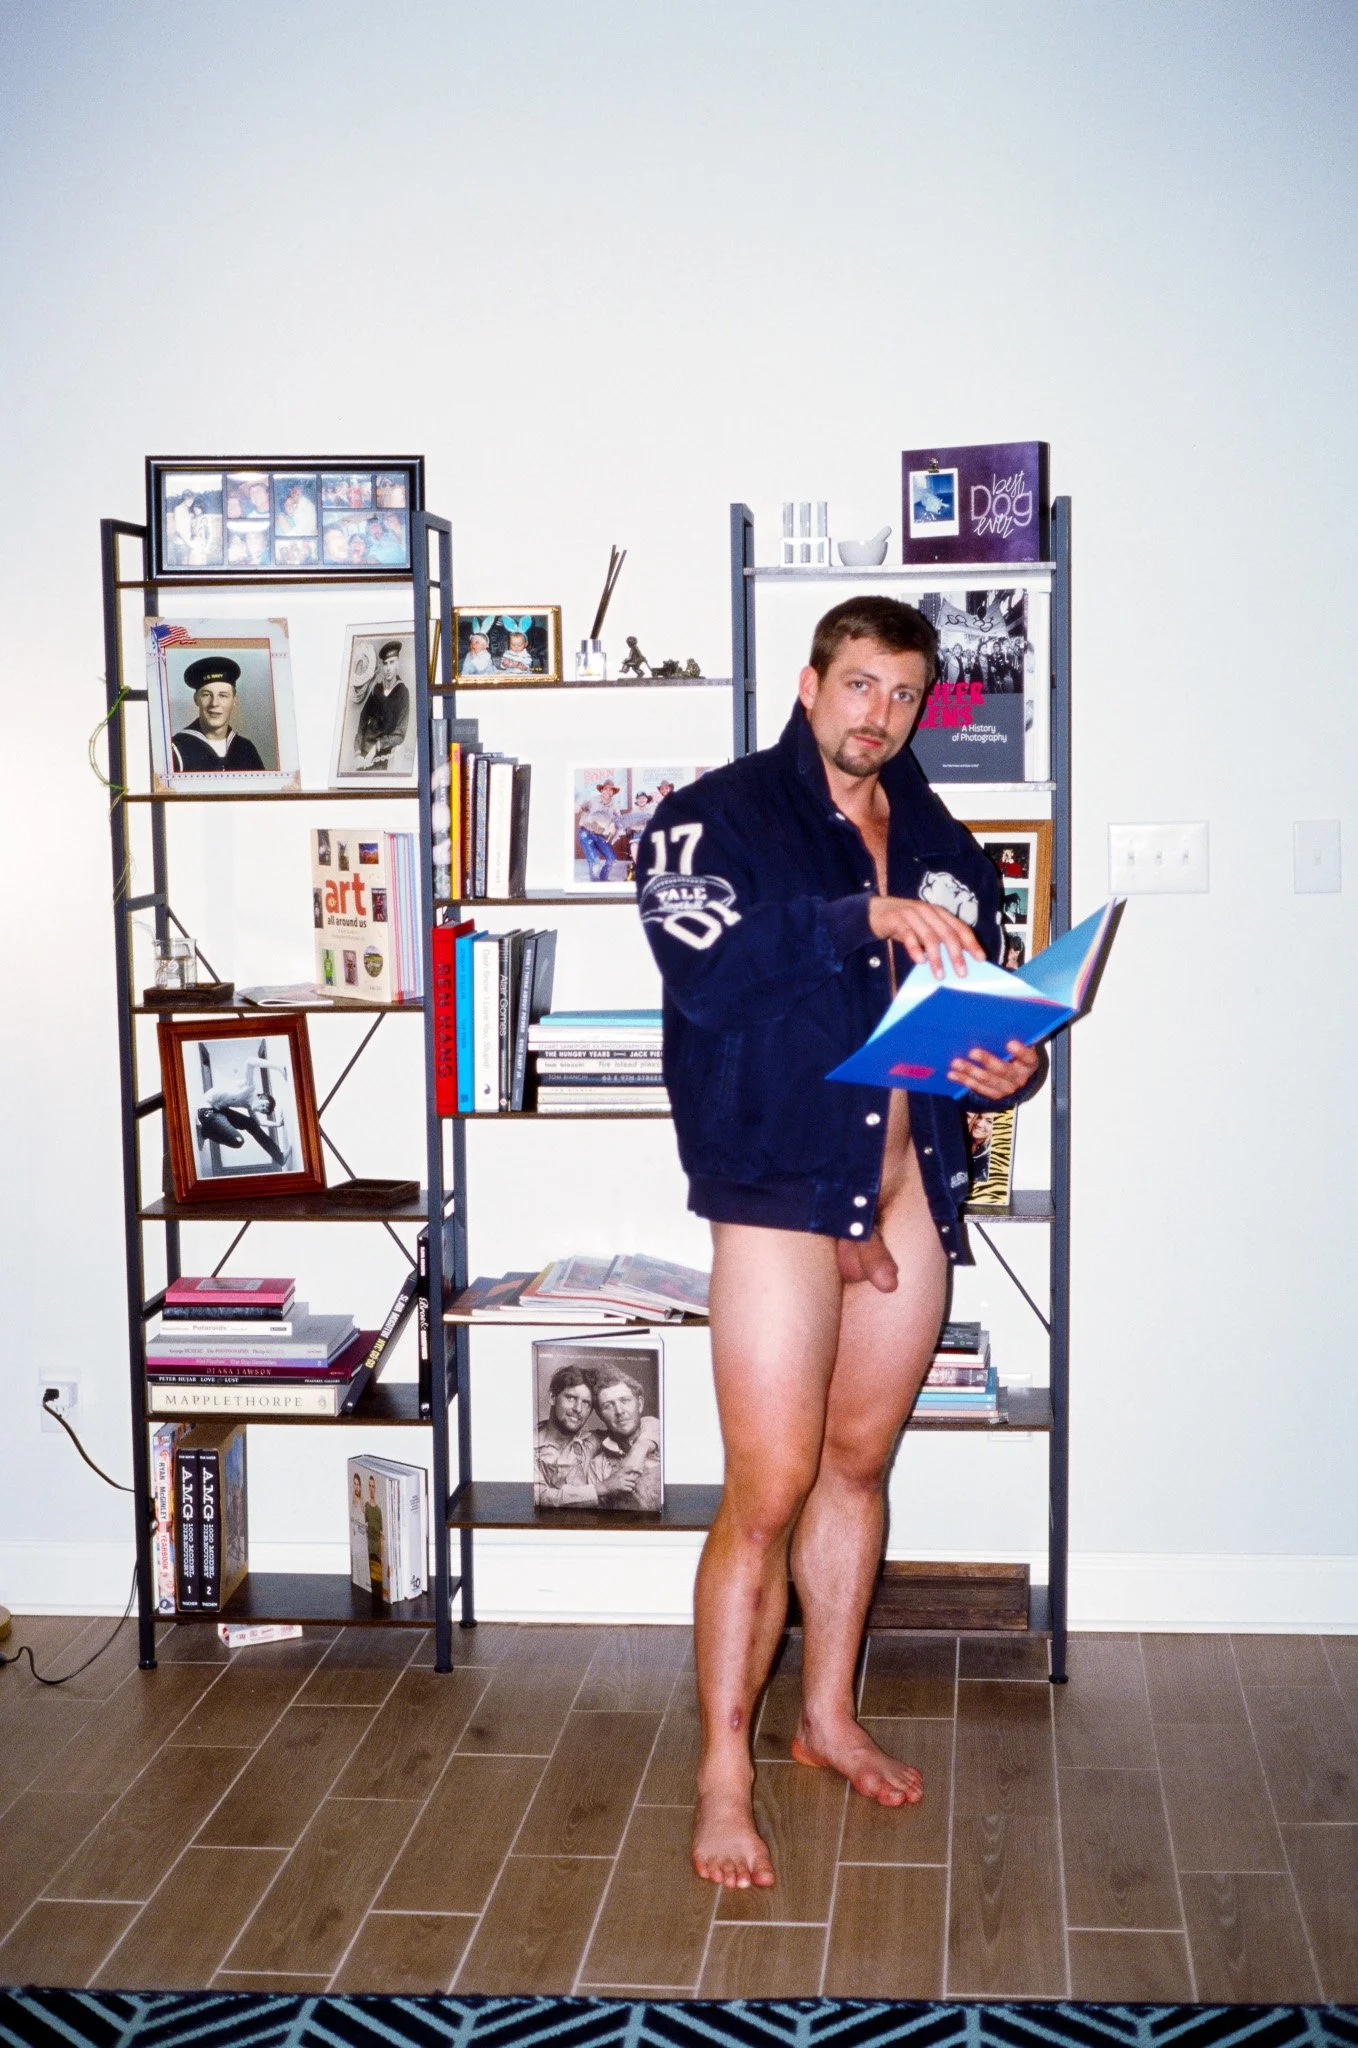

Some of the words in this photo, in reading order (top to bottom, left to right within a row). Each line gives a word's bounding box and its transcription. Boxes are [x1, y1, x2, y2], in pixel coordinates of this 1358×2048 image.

[993, 470, 1024, 497] best
[971, 485, 1033, 526] Dog
[974, 513, 1015, 538] ever
[926, 681, 985, 705] UEER
[952, 732, 960, 742] of
[960, 732, 1008, 744] Photography
[961, 724, 968, 733] A
[969, 723, 996, 734] History
[647, 823, 703, 876] 17
[325, 873, 367, 916] art
[656, 887, 707, 903] YALE
[327, 916, 335, 926] all
[336, 917, 358, 928] around
[359, 920, 367, 928] us
[438, 964, 452, 1007] REN
[499, 974, 509, 997] Alair
[499, 998, 509, 1037] Gomes
[439, 1016, 453, 1079] HANG
[165, 1395, 303, 1407] MAPPLETHORPE
[159, 1486, 167, 1520] McGINLEY
[182, 1466, 194, 1521] AMG
[202, 1466, 214, 1522] AMG
[161, 1534, 169, 1570] YEARBOOK
[187, 1585, 192, 1595] 1
[206, 1586, 212, 1595] 2
